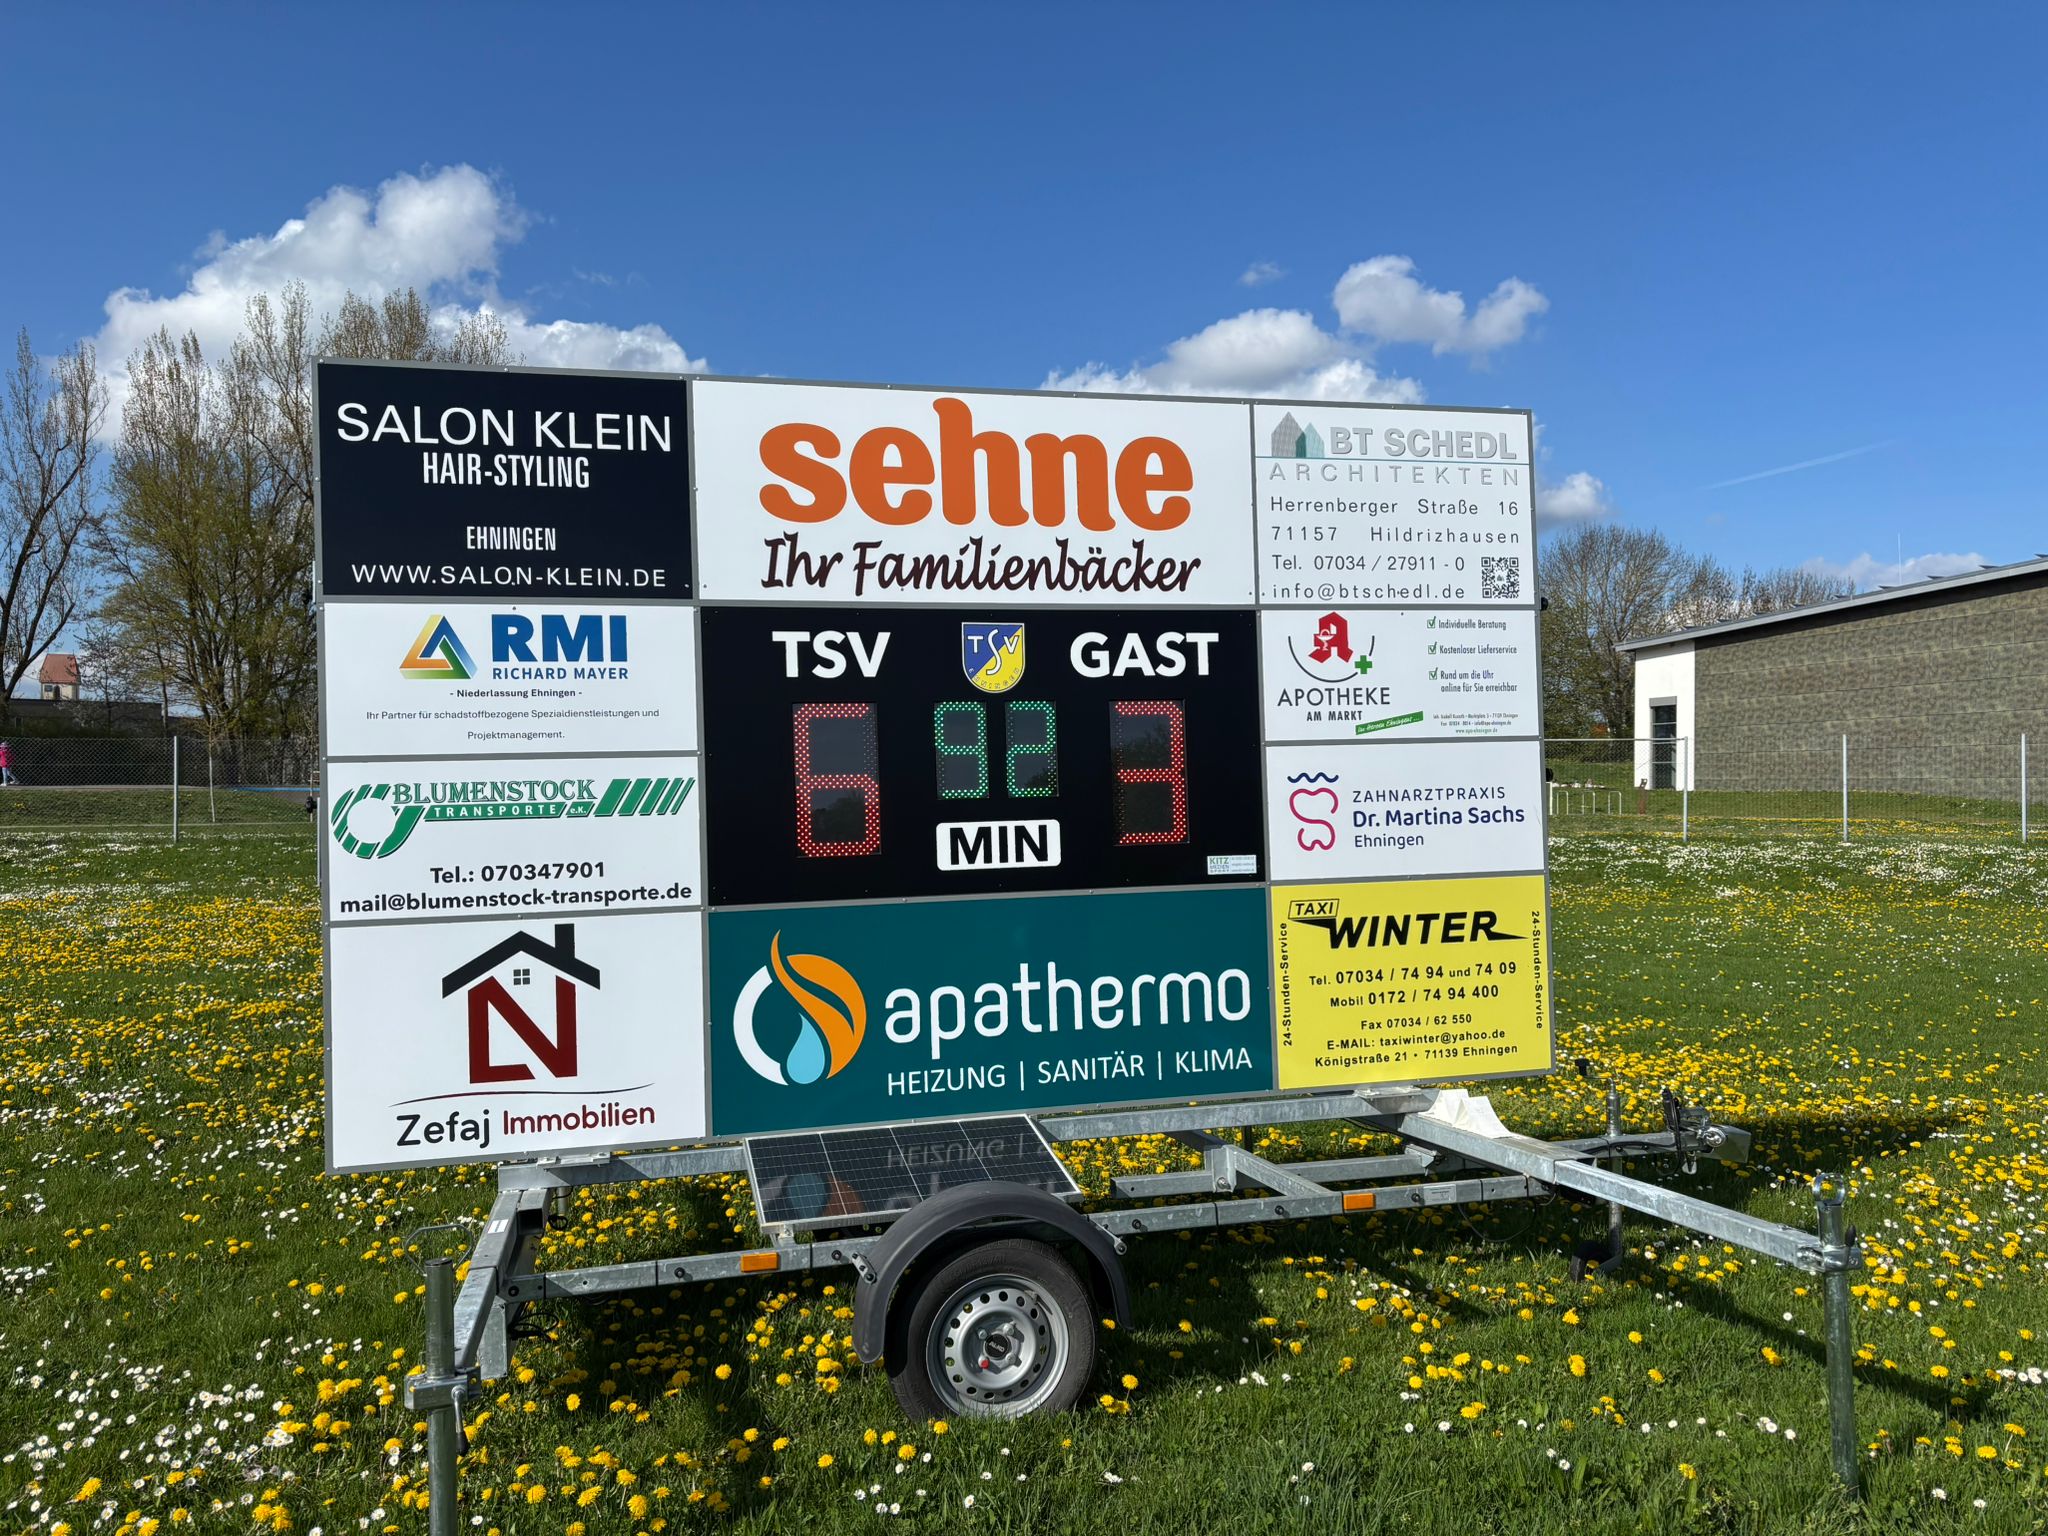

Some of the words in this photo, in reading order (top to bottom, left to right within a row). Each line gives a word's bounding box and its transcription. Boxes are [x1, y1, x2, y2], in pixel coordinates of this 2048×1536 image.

[338, 403, 513, 446] SALON
[536, 411, 670, 451] KLEIN
[1331, 427, 1373, 455] BT
[1385, 429, 1516, 459] SCHEDL
[423, 452, 589, 488] HAIR-STYLING
[759, 397, 1193, 531] sehne
[1270, 463, 1517, 485] ARCHITEKTEN
[1271, 497, 1397, 516] Herrenberger
[1418, 499, 1477, 514] Straße
[1499, 502, 1517, 515] 16
[467, 526, 555, 550] EHNINGEN
[1272, 526, 1336, 541] 71157
[1371, 527, 1518, 543] Hildrizhausen
[761, 531, 843, 588] Ihr
[853, 536, 1201, 596] Familienbäcker
[1272, 555, 1301, 570] Tel.
[1314, 556, 1365, 570] 07034
[1388, 556, 1434, 570] 27911
[352, 565, 665, 586] WWW.SALON-KLEIN.DE
[1274, 583, 1464, 600] info@btschedl.de
[1439, 619, 1476, 628] Individuelle
[1478, 619, 1506, 630] Beratung
[492, 614, 627, 662] RMI
[772, 631, 890, 678] TSV
[968, 628, 1020, 675] TSV
[1070, 632, 1219, 677] GAST
[1440, 644, 1475, 654] Kostenloser
[1478, 644, 1517, 654] Lieferservice
[493, 668, 566, 679] RICHARD
[574, 668, 628, 679] MAYER
[1441, 670, 1456, 679] Rund
[1471, 670, 1480, 679] die
[1483, 670, 1494, 679] Uhr
[457, 690, 528, 698] Niederlassung
[532, 689, 575, 698] Ehningen
[1278, 687, 1390, 706] APOTHEKE
[1441, 682, 1461, 692] online
[1463, 682, 1472, 692] für
[1474, 683, 1483, 692] Sie
[1486, 682, 1517, 692] erreichbar
[435, 711, 529, 719] schadstoffbezogene
[532, 710, 640, 719] Spezialdienstleistungen
[1307, 711, 1321, 721] AM
[1328, 711, 1362, 720] MARKT
[468, 732, 564, 740] Projektmanagement.
[793, 703, 880, 857] 6
[1114, 700, 1189, 844] 3
[392, 779, 598, 805] BLUMENSTOCK
[1353, 787, 1505, 802] ZAHNARZTPRAXIS
[434, 804, 556, 817] TRANSPORTE
[570, 806, 587, 814] e.K.
[1353, 811, 1380, 827] Dr.
[1386, 807, 1462, 826] Martina
[1468, 806, 1524, 824] Sachs
[950, 825, 1048, 865] MIN
[1355, 834, 1423, 849] Ehningen
[430, 866, 473, 883] Tel.:
[482, 862, 603, 881] 070347901
[340, 882, 692, 913] mail@blumenstock-transporte.de
[1295, 902, 1333, 915] TAXI
[1329, 911, 1518, 949] WINTER
[1309, 976, 1330, 985] Tel.
[1336, 969, 1383, 984] 07034
[1401, 967, 1419, 980] 74
[1426, 966, 1443, 978] 94
[1449, 967, 1471, 977] und
[1476, 963, 1492, 975] 74
[1500, 962, 1516, 974] 09
[1532, 911, 1543, 1028] 24-Stunden-Service
[1279, 923, 1292, 1046] 24-Stunden-Service
[1331, 996, 1364, 1007] Mobil
[1369, 991, 1405, 1004] 0172
[1424, 988, 1441, 1001] 74
[1448, 987, 1465, 999] 94
[1472, 985, 1498, 998] 400
[885, 962, 1251, 1060] apathermo
[1361, 1021, 1382, 1030] Fax
[1387, 1017, 1421, 1028] 07034
[1434, 1016, 1446, 1025] 62
[1453, 1014, 1471, 1024] 550
[1327, 1039, 1374, 1050] E-MAIL:
[1380, 1029, 1505, 1046] taxiwinter@yahoo.de
[1315, 1053, 1389, 1067] Königstraße
[1395, 1052, 1406, 1061] 21
[1425, 1048, 1458, 1058] 71139
[1463, 1046, 1517, 1056] Ehningen
[888, 1065, 1005, 1095] HEIZUNG
[1039, 1051, 1144, 1083] SANITÄR
[1176, 1048, 1252, 1073] KLIMA
[397, 1109, 489, 1148] Zefaj
[504, 1102, 655, 1135] Immobilien
